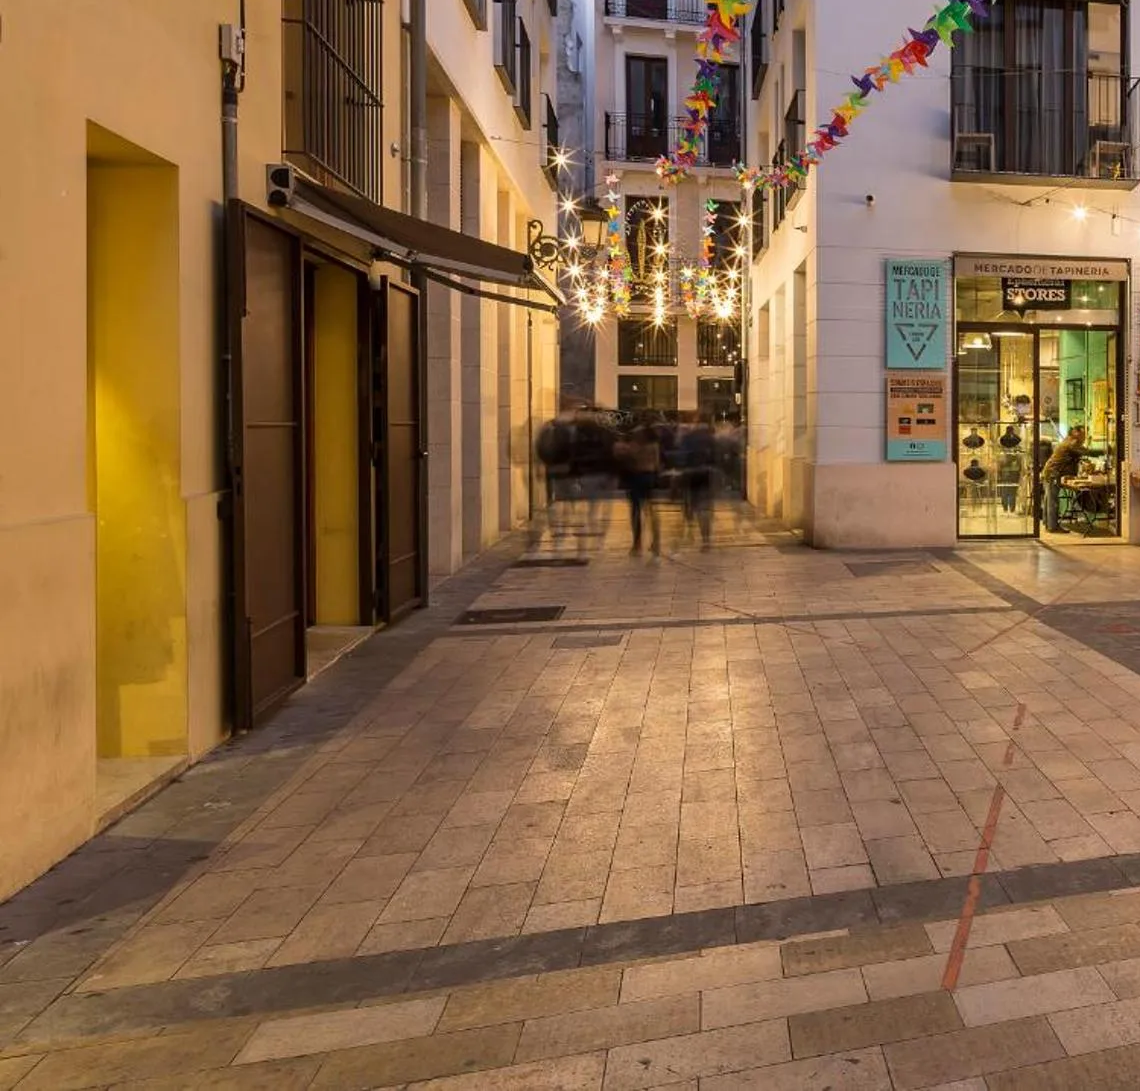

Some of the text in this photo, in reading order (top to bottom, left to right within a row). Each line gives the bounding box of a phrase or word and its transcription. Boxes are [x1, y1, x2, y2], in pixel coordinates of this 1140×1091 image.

[974, 263, 1033, 274] MERCADO
[1050, 266, 1110, 276] TAPINERIA
[893, 279, 940, 300] TAPI
[1007, 288, 1065, 301] STORES
[893, 301, 942, 319] NERIA
